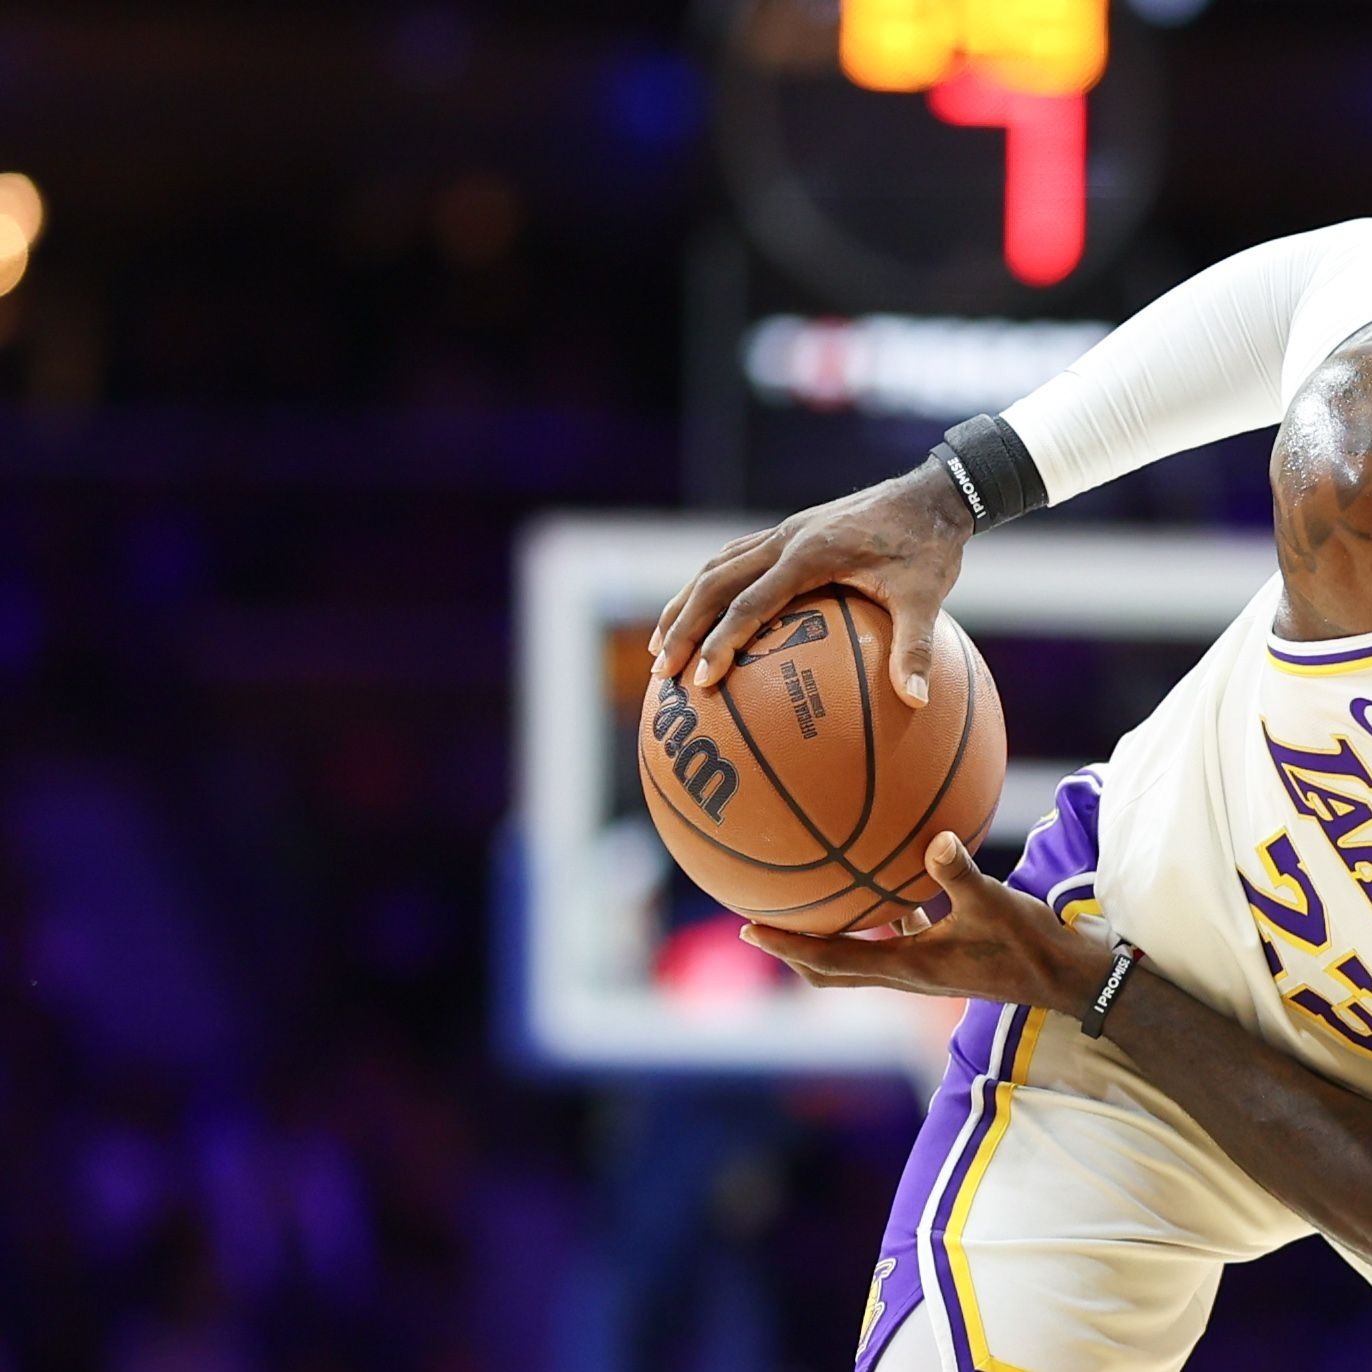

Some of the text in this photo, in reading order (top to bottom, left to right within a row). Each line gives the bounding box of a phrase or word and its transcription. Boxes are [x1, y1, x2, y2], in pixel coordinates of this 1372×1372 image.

[947, 456, 987, 519] I PROMISE
[794, 700, 818, 739] OFFICIAL
[1093, 956, 1131, 1014] I PROMISE
